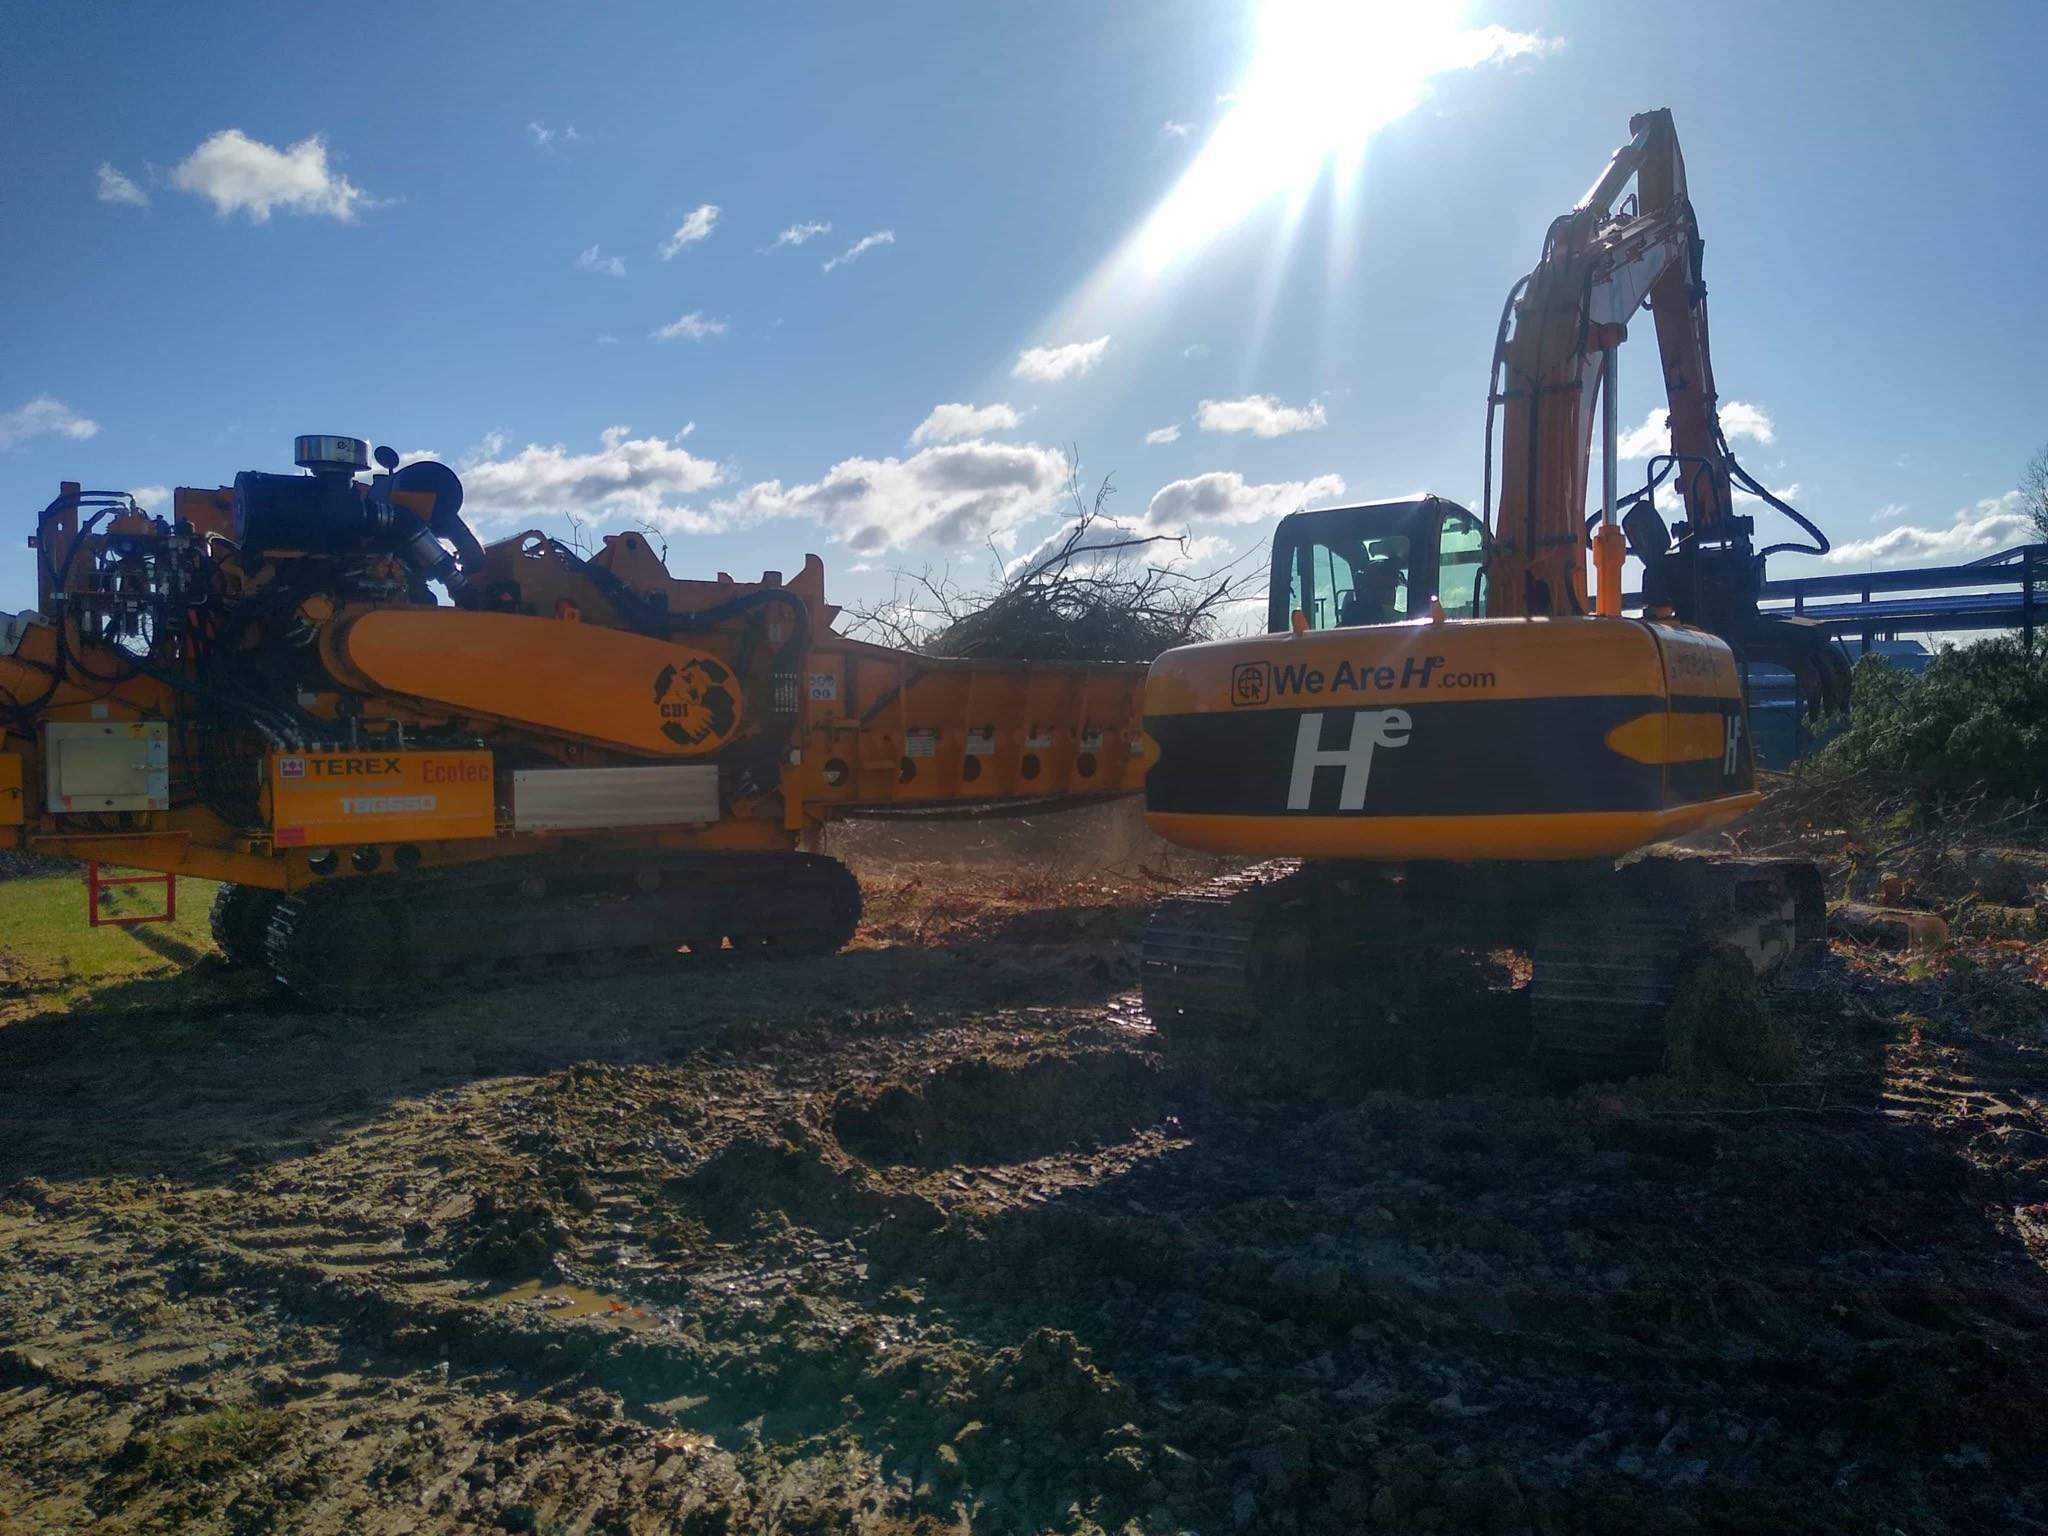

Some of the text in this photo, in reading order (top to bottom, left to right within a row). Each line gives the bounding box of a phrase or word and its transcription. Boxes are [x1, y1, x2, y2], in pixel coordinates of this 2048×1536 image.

[311, 757, 402, 776] TEREX
[422, 759, 490, 784] Ecotec
[1286, 708, 1413, 810] He
